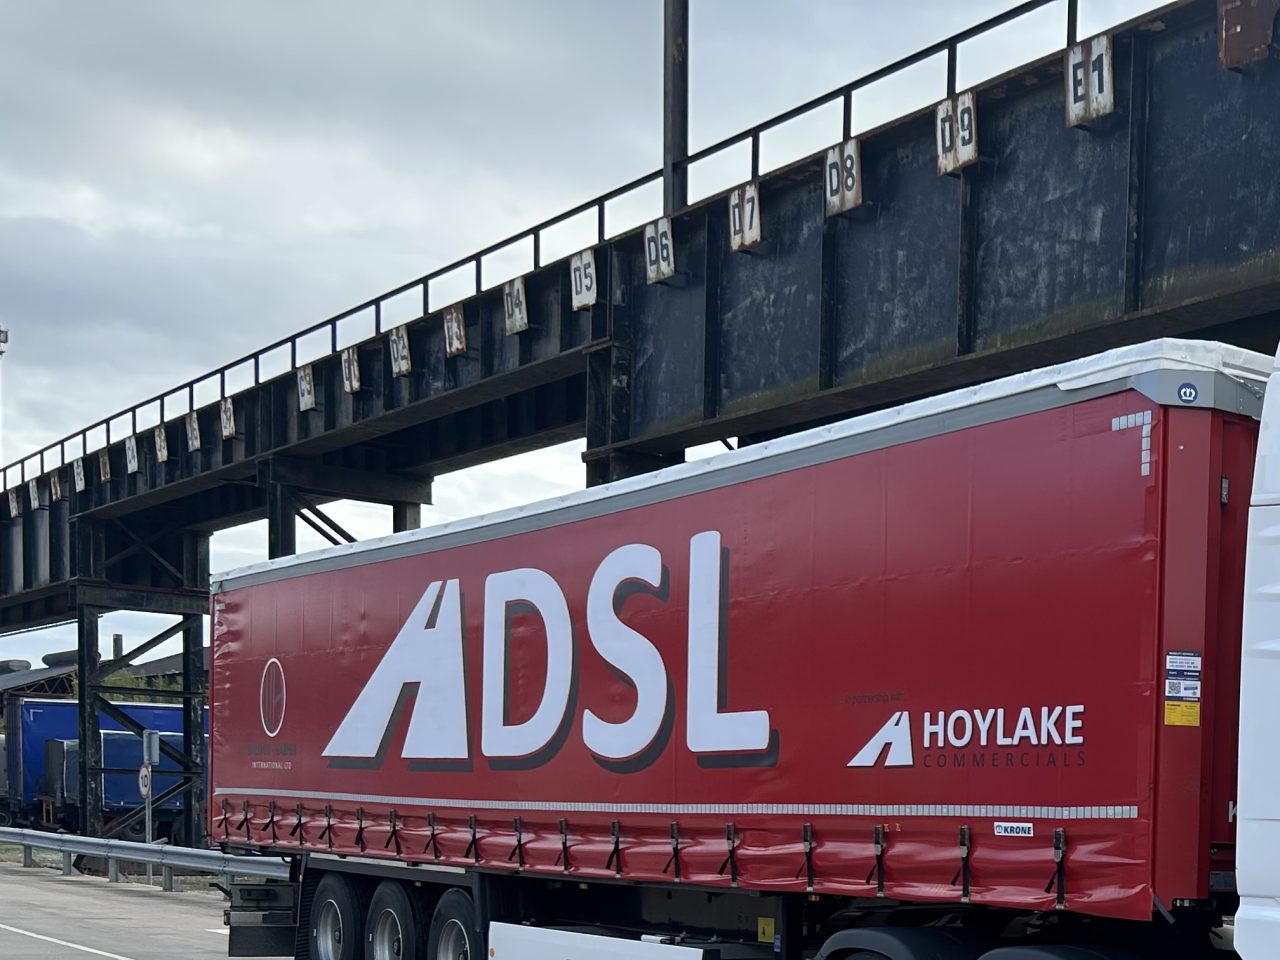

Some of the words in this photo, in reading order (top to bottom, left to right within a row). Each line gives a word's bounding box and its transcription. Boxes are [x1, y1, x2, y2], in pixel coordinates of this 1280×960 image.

[1072, 53, 1105, 104] E1
[941, 106, 973, 153] D9
[829, 154, 856, 197] D8
[732, 195, 755, 236] D7
[647, 230, 670, 267] D6
[573, 262, 593, 296] D5
[504, 288, 522, 320] D4
[390, 332, 407, 358] D2
[321, 530, 776, 770] ADSL
[923, 704, 1085, 748] HOYLAKE
[923, 751, 1086, 768] COMMERCIALS
[141, 774, 148, 788] 10
[1003, 825, 1032, 835] KRONE
